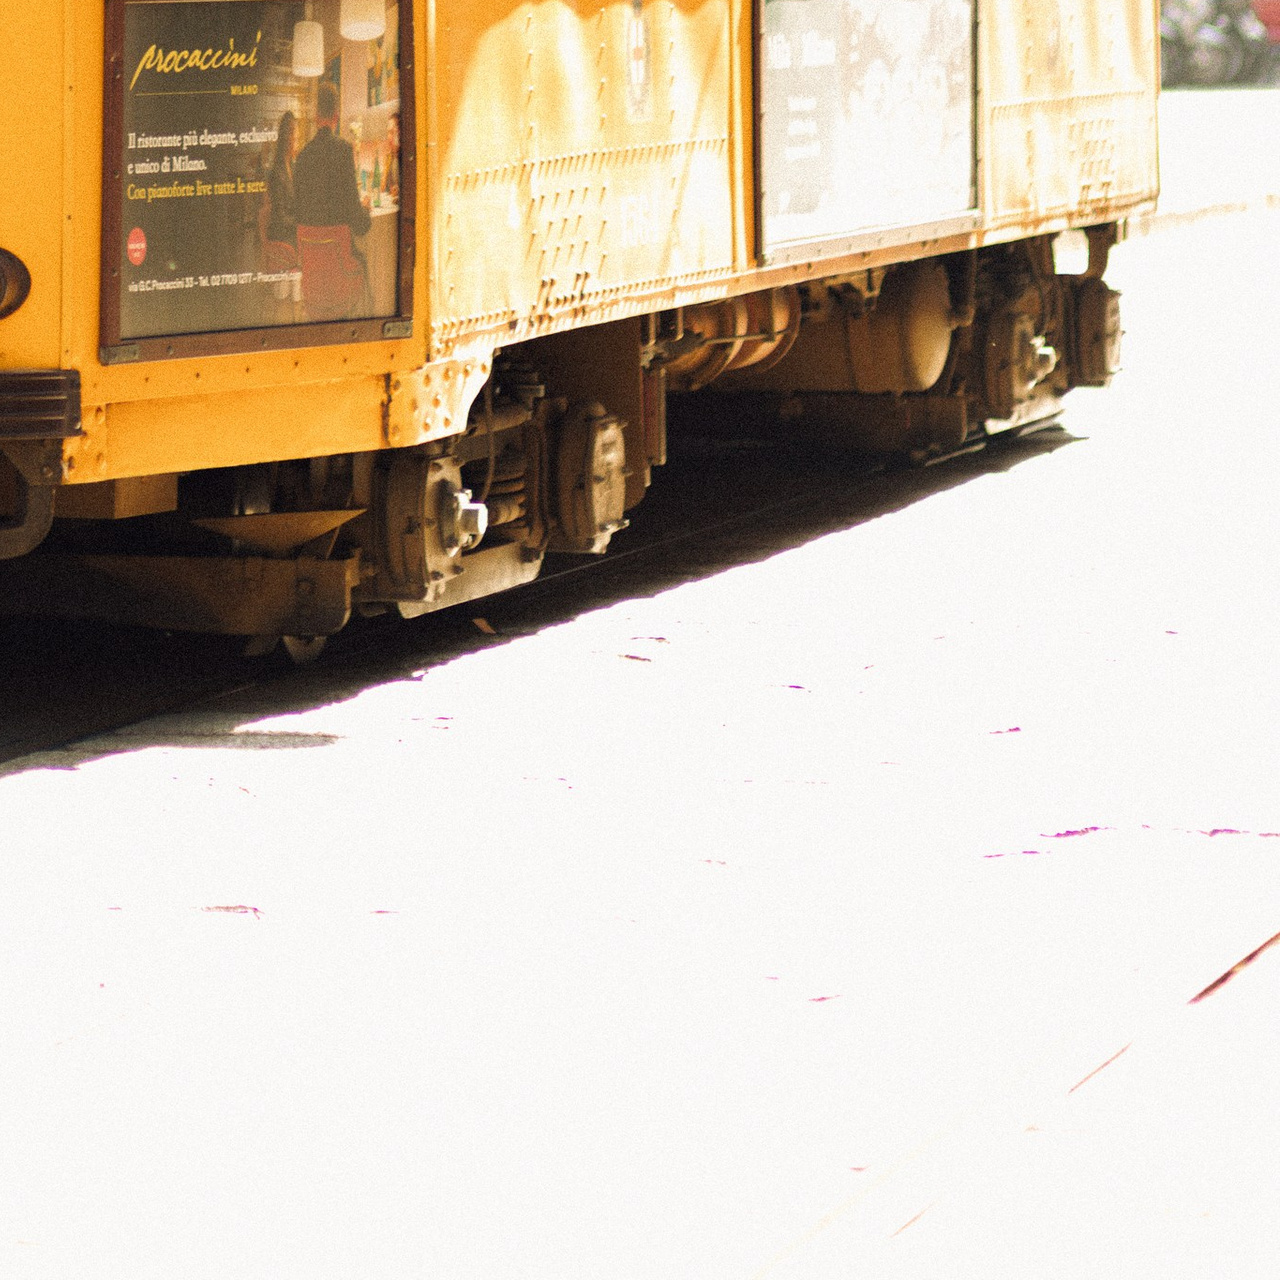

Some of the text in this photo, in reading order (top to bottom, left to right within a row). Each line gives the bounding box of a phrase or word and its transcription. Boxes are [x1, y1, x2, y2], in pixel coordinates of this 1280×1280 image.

[230, 84, 259, 96] MILANO
[128, 132, 136, 149] Il
[137, 133, 182, 148] ristorante
[183, 130, 198, 150] più
[199, 129, 238, 148] elegante,
[127, 155, 208, 175] e unico di Milano.
[127, 184, 146, 200] Con
[147, 181, 195, 203] pianoforte
[196, 180, 212, 196] live
[214, 182, 236, 195] tutte
[237, 177, 246, 193] le
